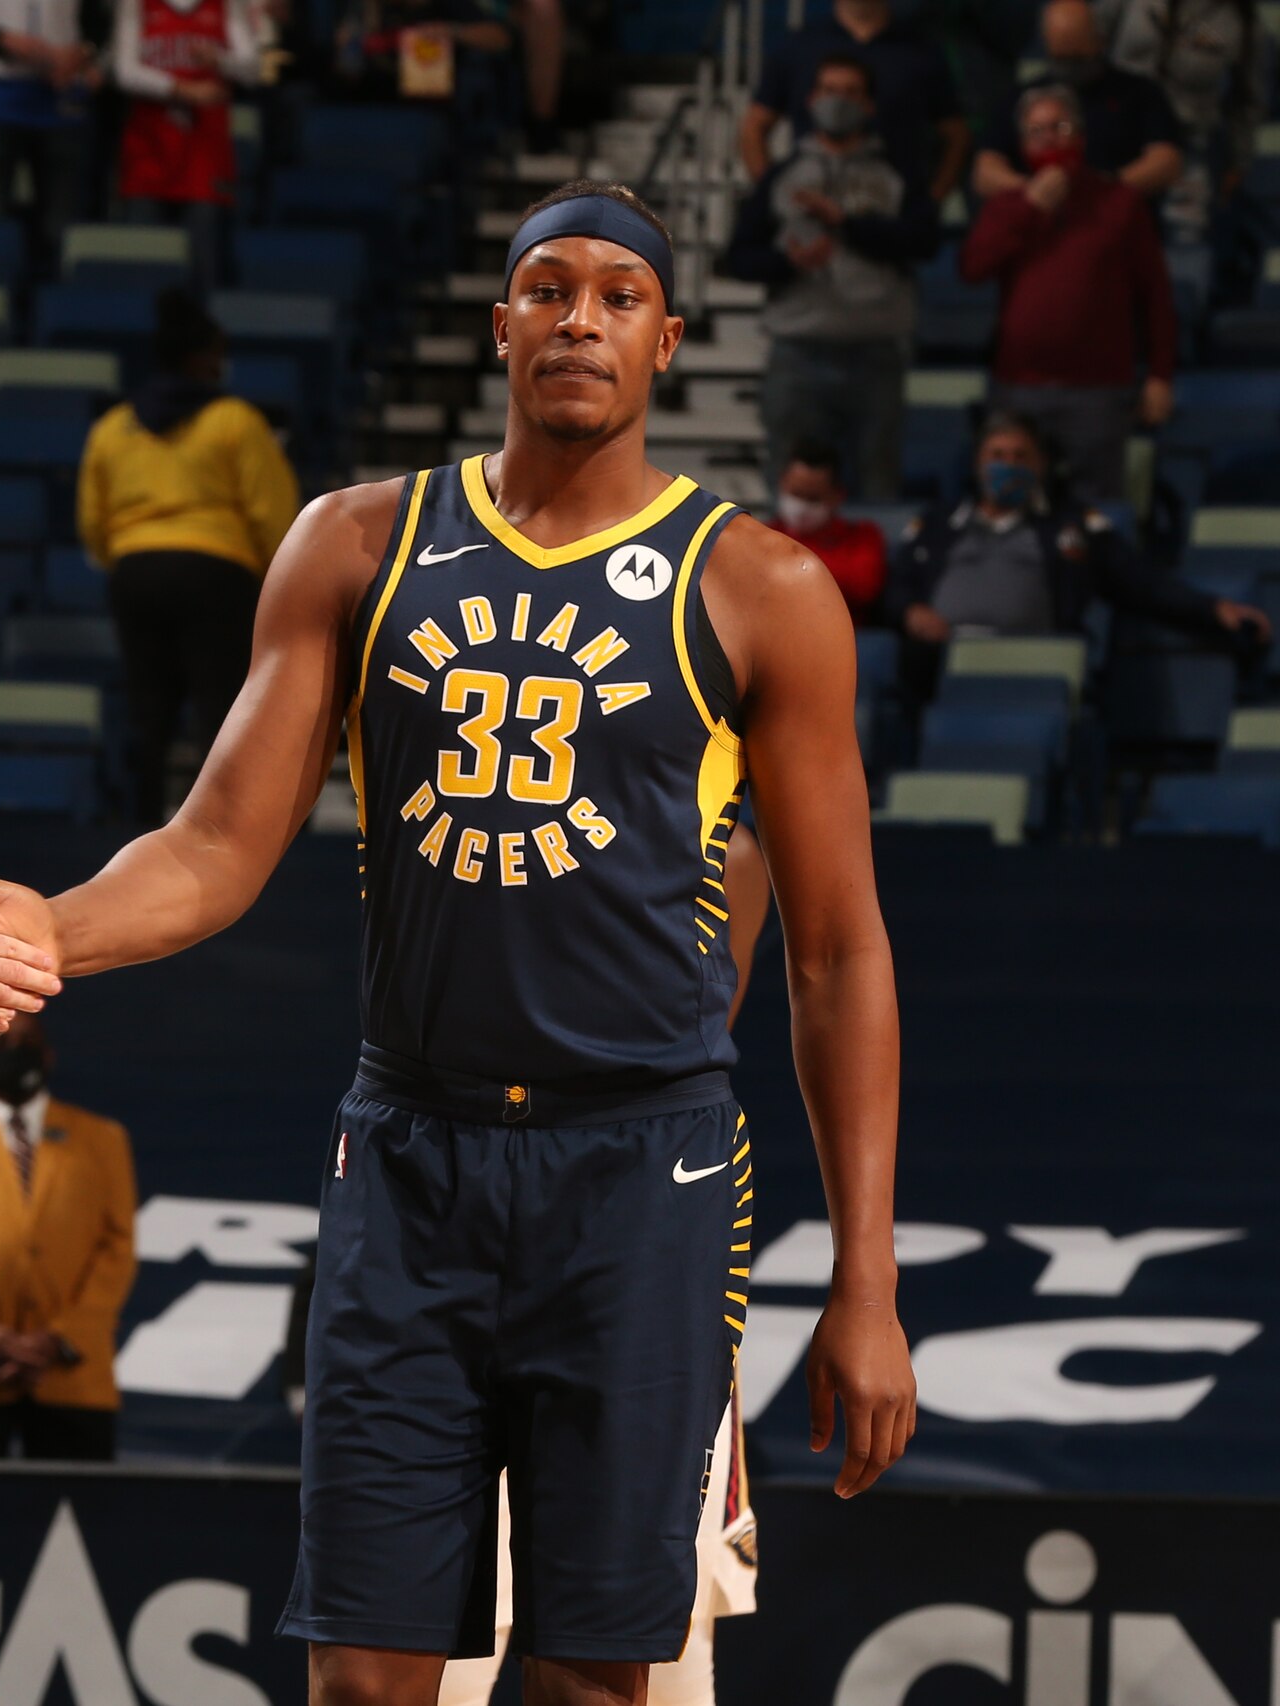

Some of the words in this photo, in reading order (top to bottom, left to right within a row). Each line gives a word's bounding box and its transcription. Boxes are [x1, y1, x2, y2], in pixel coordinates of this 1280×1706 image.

[387, 592, 652, 716] INDIANA
[436, 667, 584, 805] 33
[400, 779, 618, 887] PACERS
